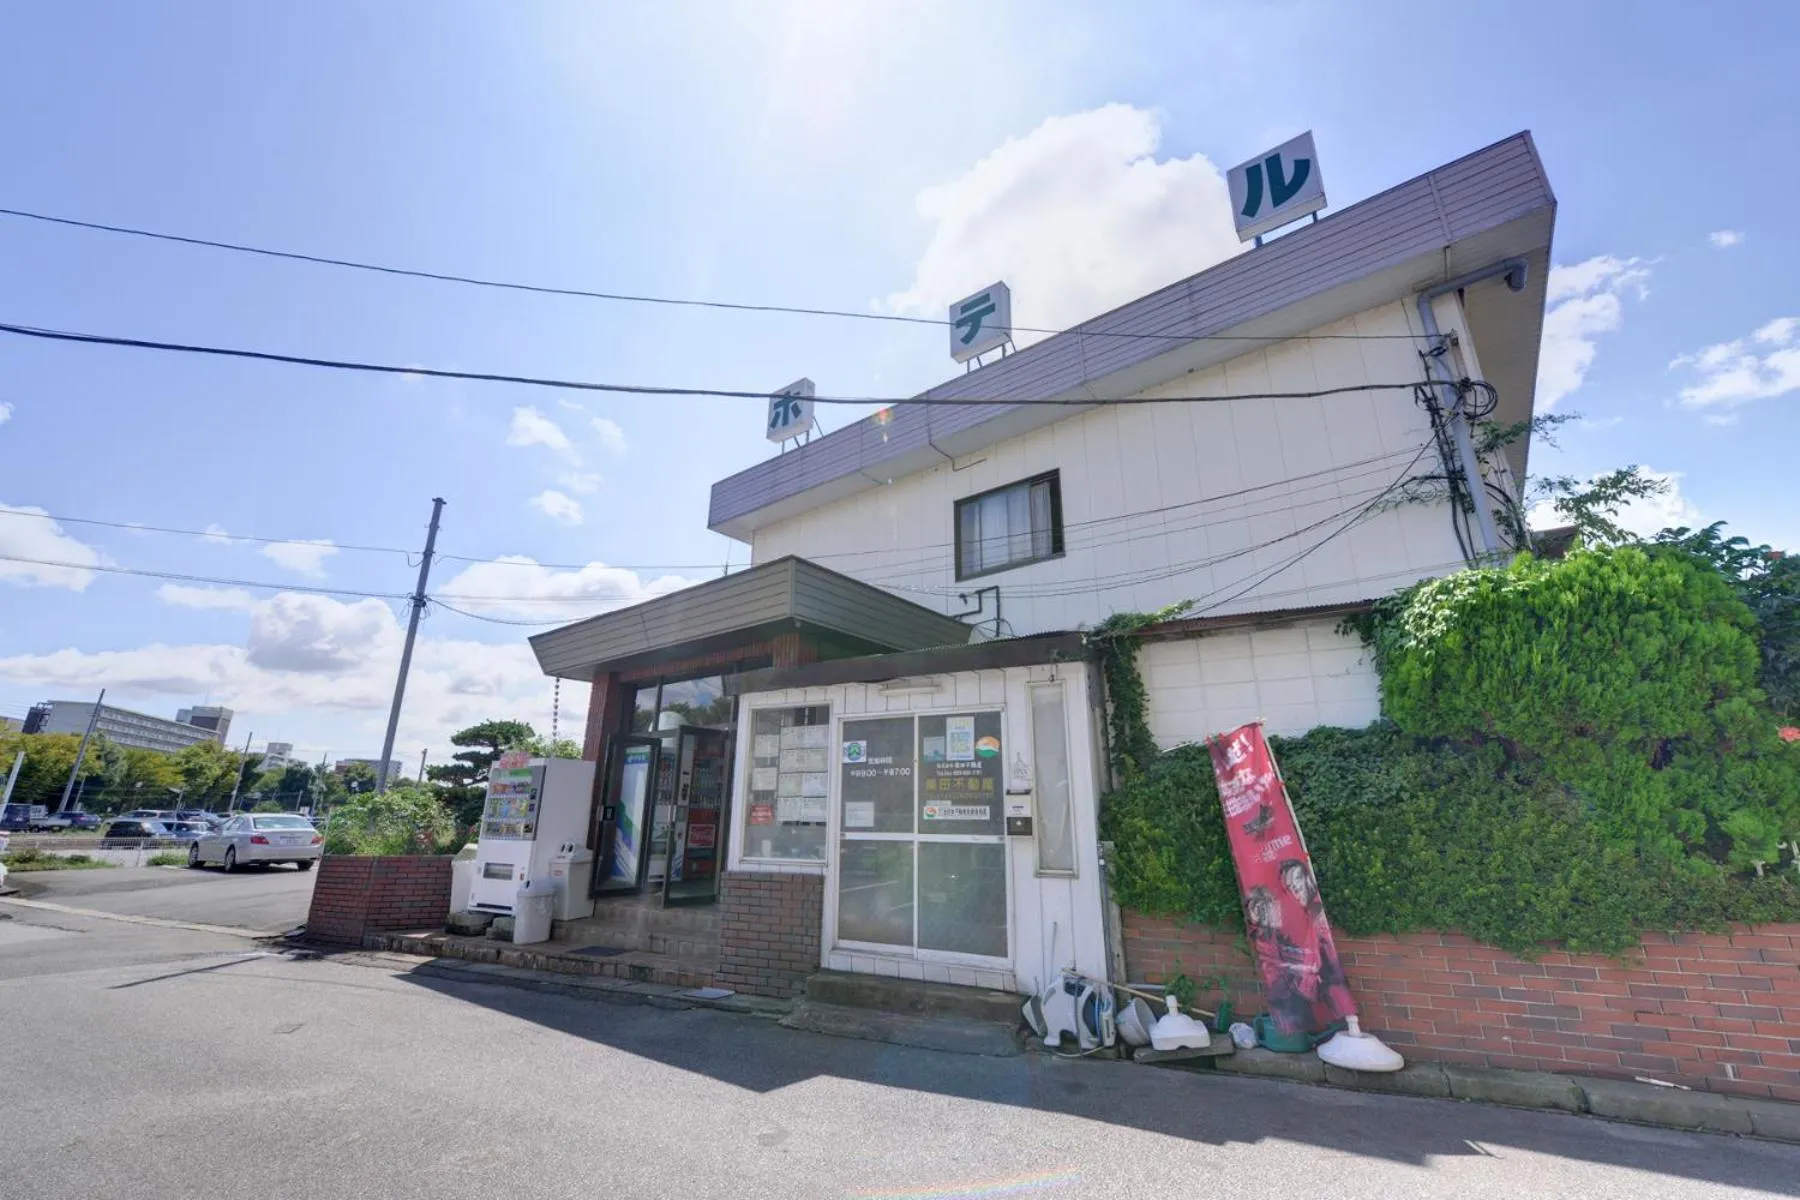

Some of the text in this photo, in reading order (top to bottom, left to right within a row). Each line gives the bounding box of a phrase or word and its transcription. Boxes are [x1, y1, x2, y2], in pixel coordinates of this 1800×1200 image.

[770, 152, 1311, 429] ホ テ ル
